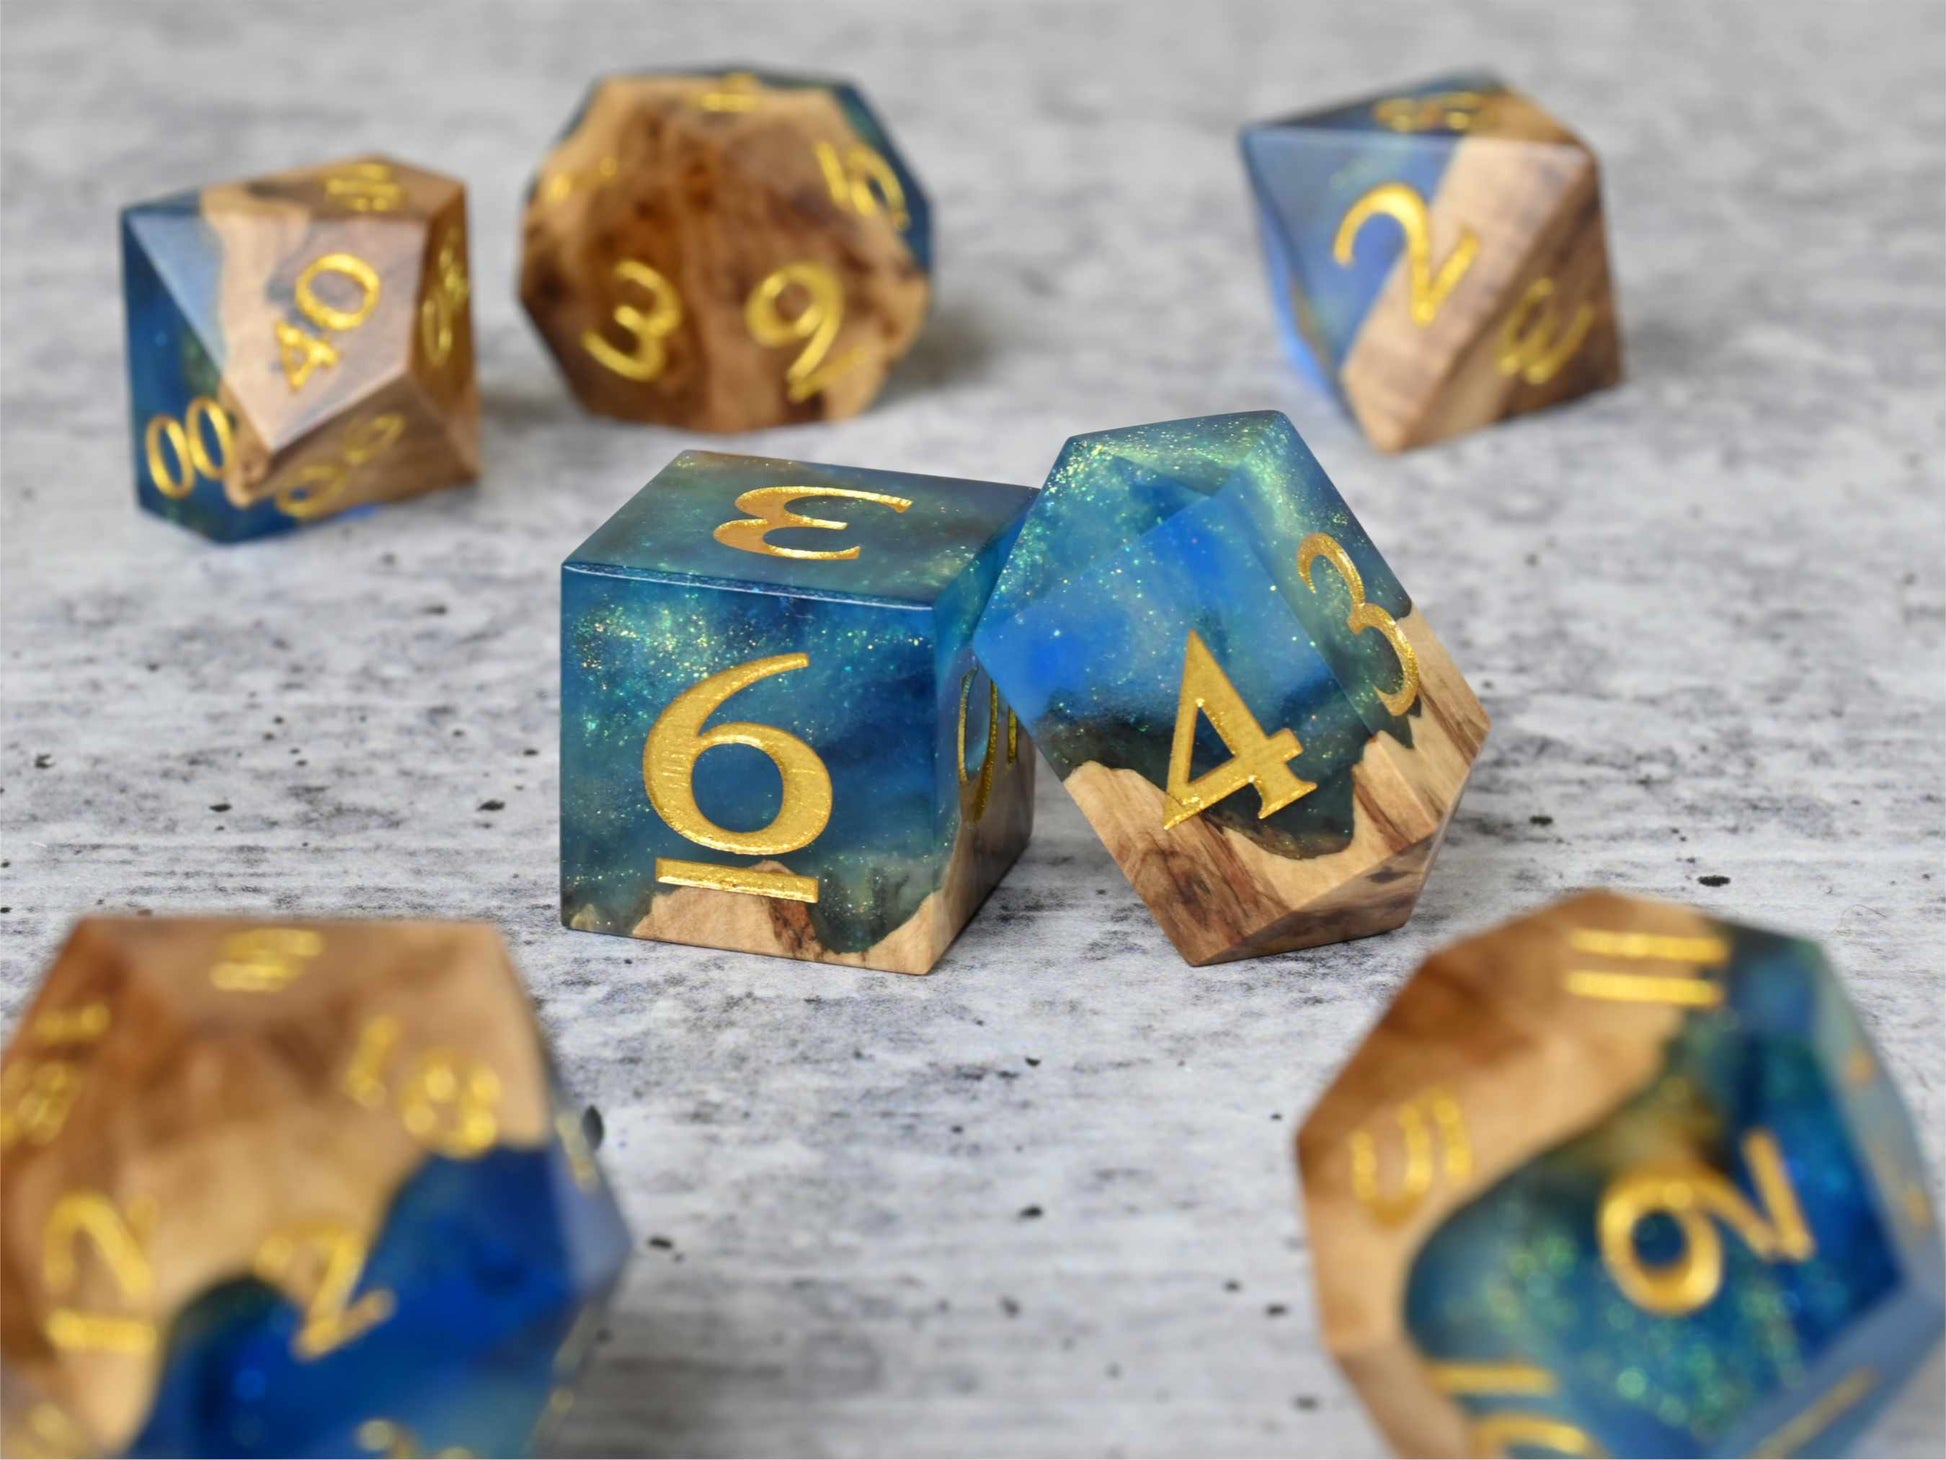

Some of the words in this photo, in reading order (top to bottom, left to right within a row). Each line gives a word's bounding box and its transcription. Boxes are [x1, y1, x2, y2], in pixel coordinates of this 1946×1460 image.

[273, 253, 381, 391] 40
[581, 258, 683, 382] 3
[1333, 183, 1480, 328] 2
[145, 396, 236, 498] 00
[713, 485, 913, 560] 3
[1299, 532, 1420, 717] 3
[643, 652, 834, 864] 6
[1163, 629, 1319, 831] 4
[1565, 926, 1731, 1007] 11
